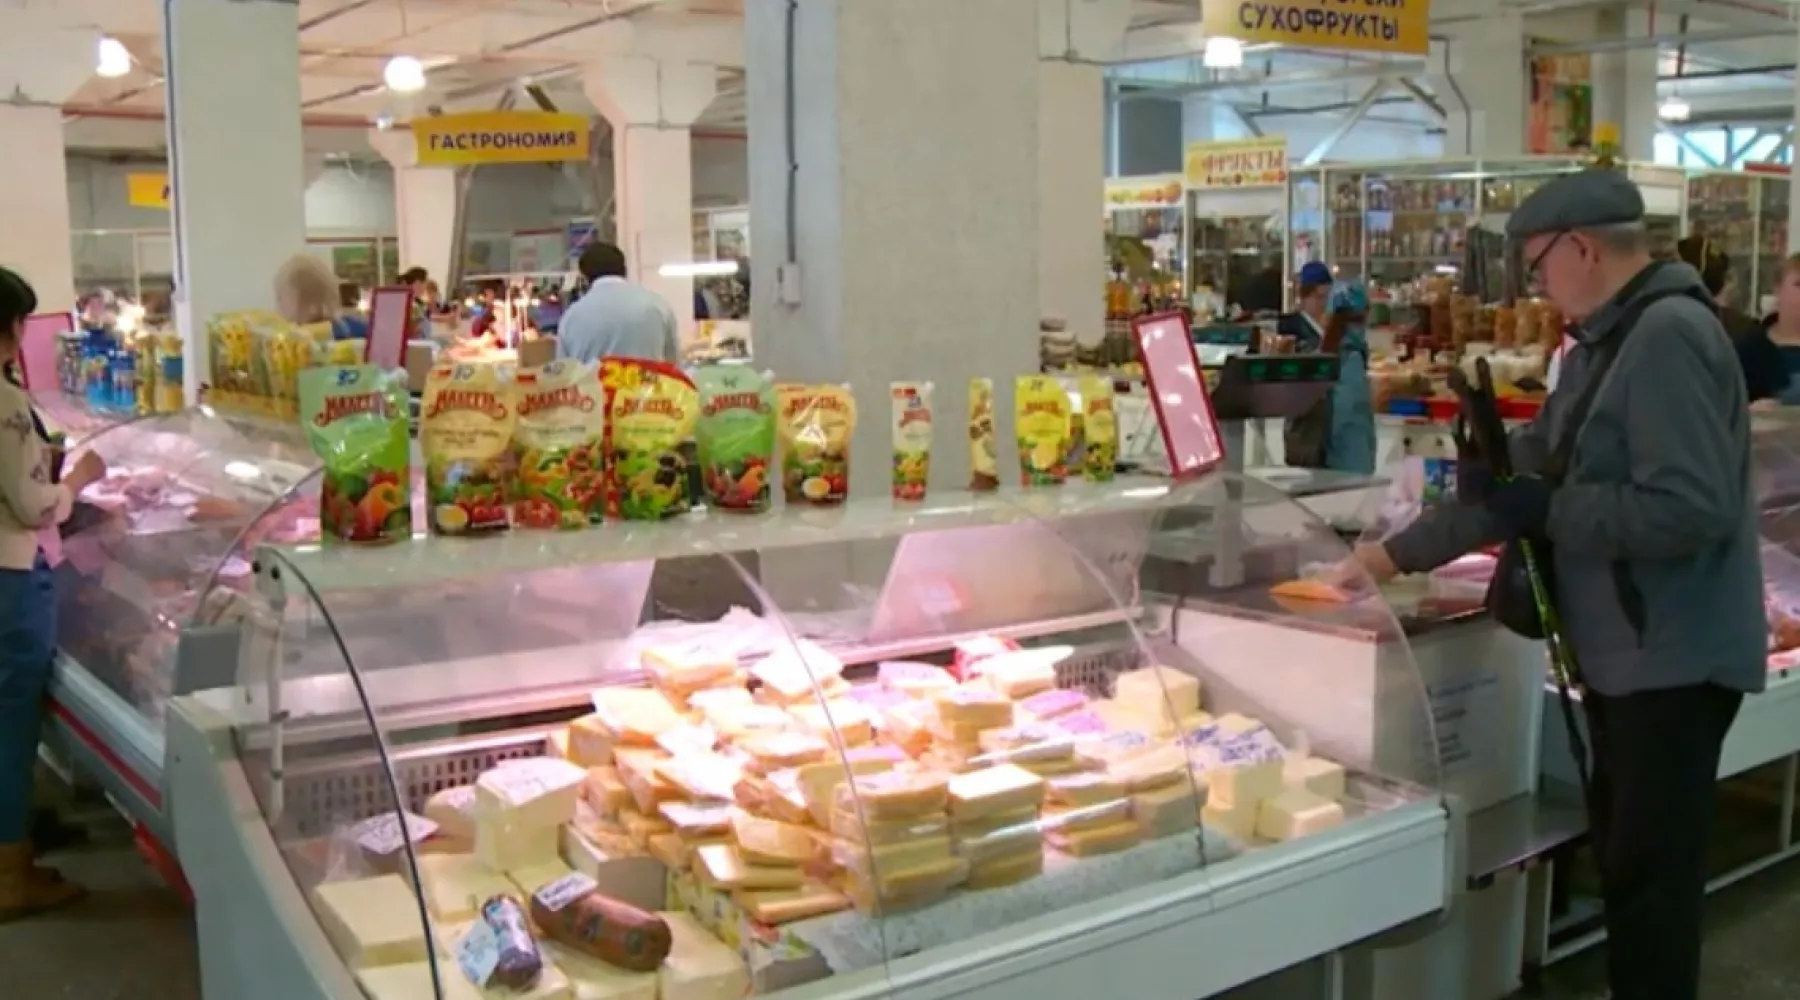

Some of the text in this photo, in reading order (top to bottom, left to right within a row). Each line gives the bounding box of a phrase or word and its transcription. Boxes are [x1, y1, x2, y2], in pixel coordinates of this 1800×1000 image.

[1239, 3, 1398, 41] СУХОФРУКТЫ
[430, 131, 577, 151] ГАСТРОНОМИЯ
[1201, 151, 1284, 174] ФРУКТЫ
